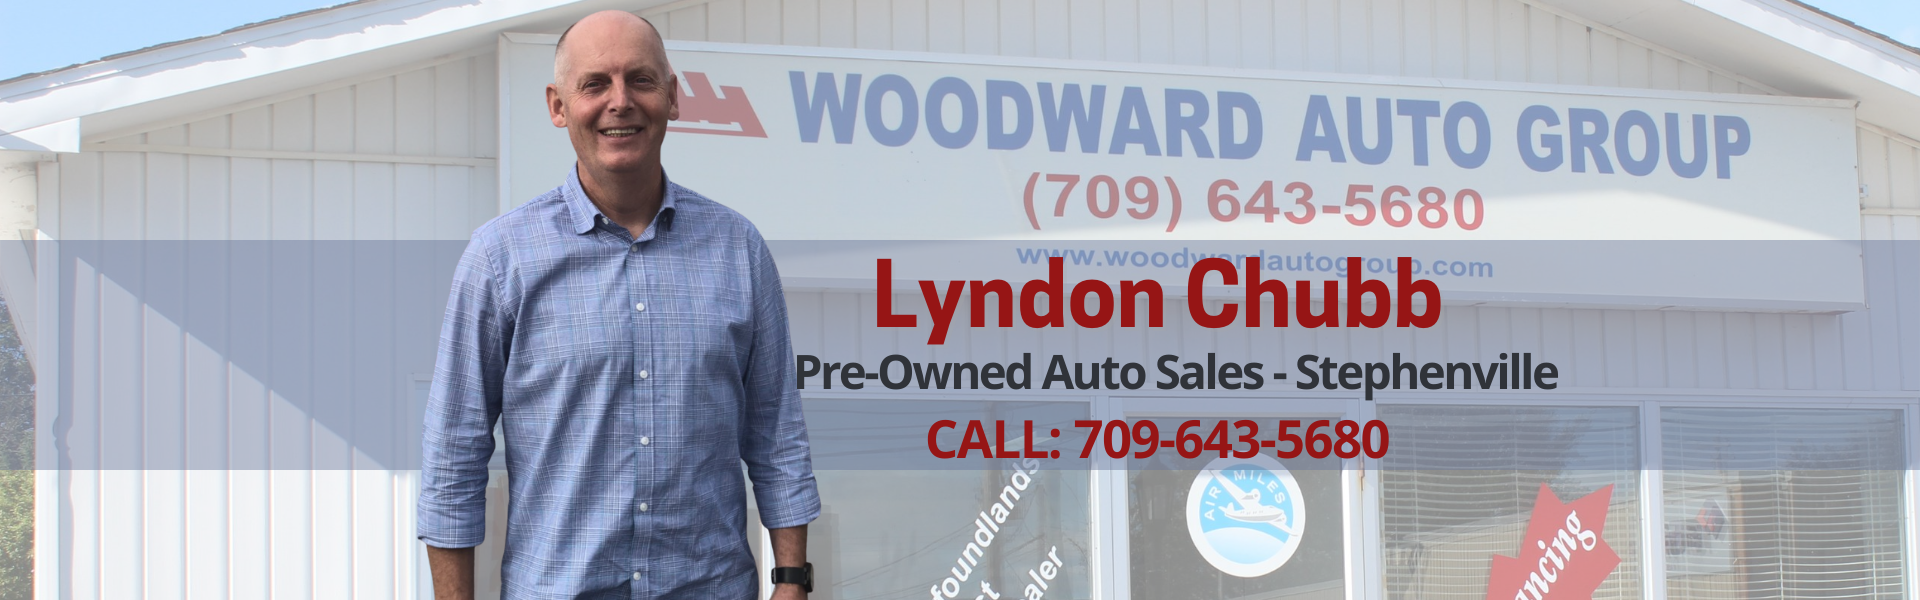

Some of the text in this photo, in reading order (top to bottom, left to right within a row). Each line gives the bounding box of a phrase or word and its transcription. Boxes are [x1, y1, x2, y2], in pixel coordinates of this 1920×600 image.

[788, 70, 1751, 180] WOODWARD AUTO GROUP
[1023, 171, 1485, 232] (709) 643-5680
[1204, 469, 1286, 521] AIR MILES
